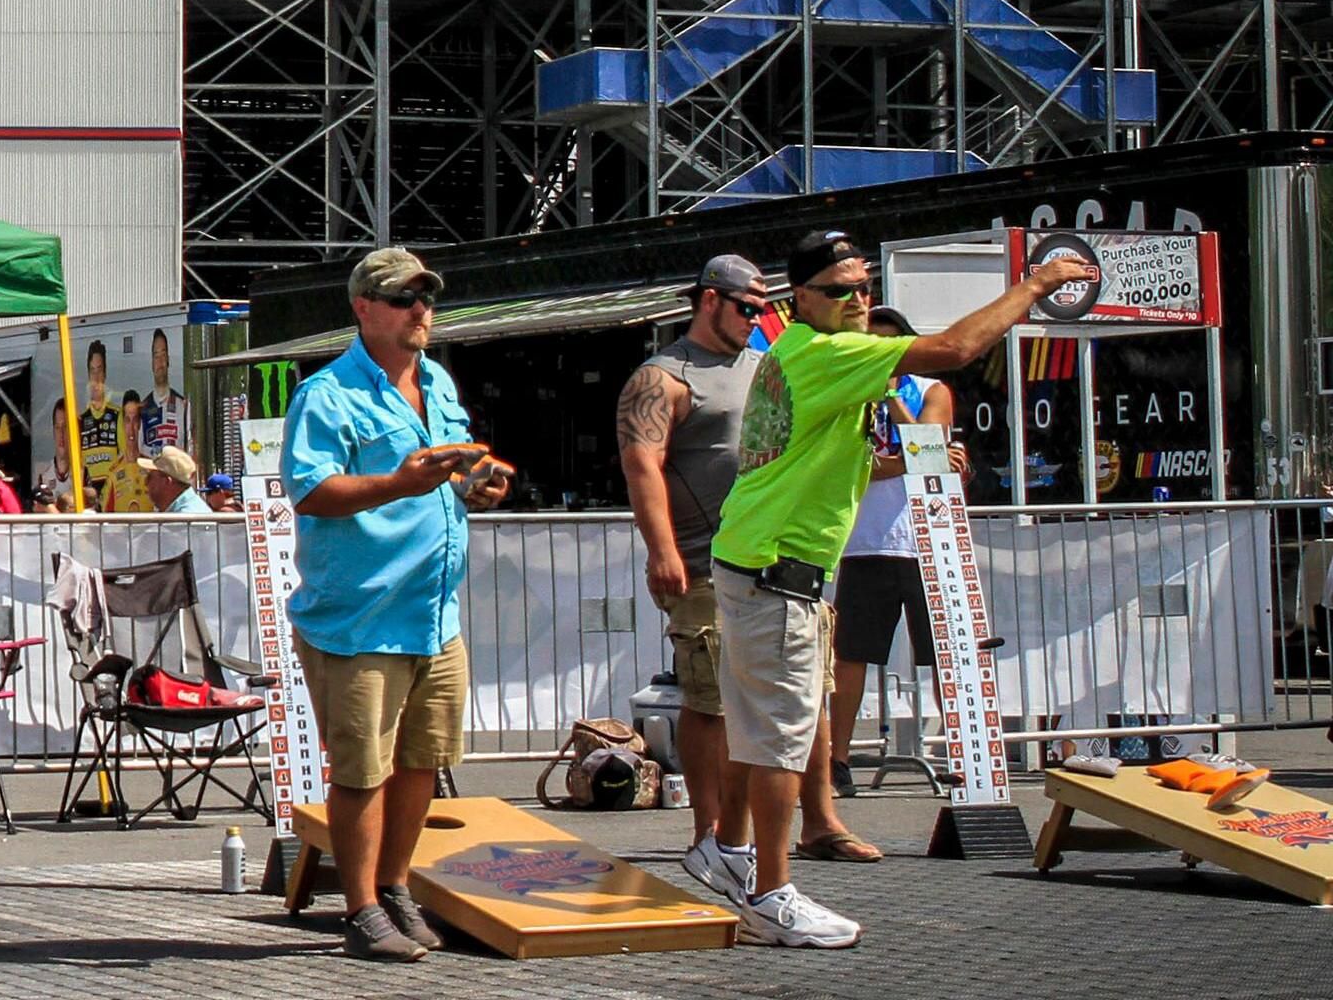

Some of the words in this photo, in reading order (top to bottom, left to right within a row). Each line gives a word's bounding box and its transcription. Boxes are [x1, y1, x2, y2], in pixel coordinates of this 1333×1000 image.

[1101, 242, 1161, 261] Purchase
[1163, 239, 1193, 252] Your
[1116, 257, 1164, 274] Chance
[1167, 254, 1183, 266] To
[1119, 275, 1146, 289] Win
[1148, 272, 1166, 288] Up
[1169, 269, 1184, 281] To
[1117, 282, 1192, 307] $100,000
[1139, 308, 1165, 319] Tickets
[1166, 310, 1184, 320] Only
[270, 482, 281, 496] 2
[930, 478, 938, 491] 1
